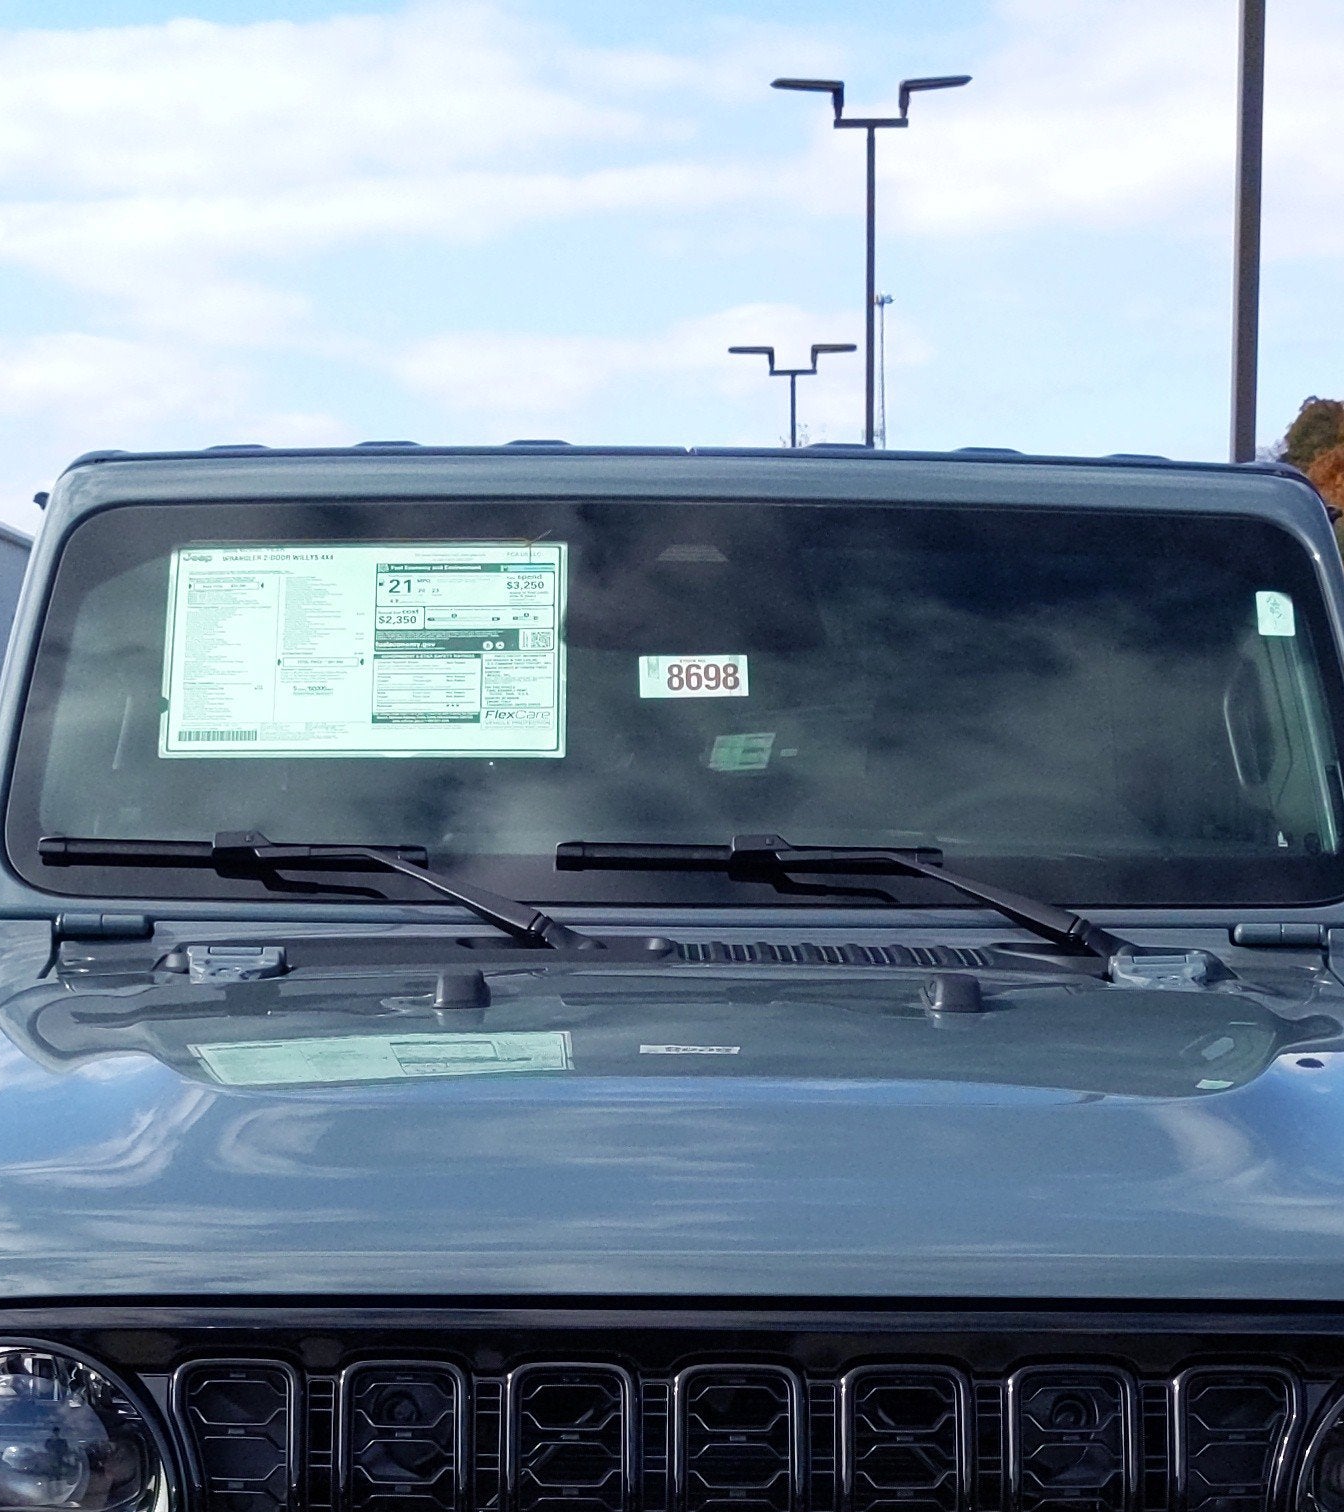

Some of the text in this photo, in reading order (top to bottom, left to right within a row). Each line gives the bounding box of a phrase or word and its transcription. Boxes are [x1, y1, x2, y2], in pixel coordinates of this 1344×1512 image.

[183, 554, 213, 563] Jeep
[222, 554, 262, 562] WRANGLER
[388, 579, 412, 594] 21
[506, 581, 545, 591] $3,250
[378, 615, 417, 625] $2,350
[667, 663, 740, 691] 8698
[485, 710, 551, 720] FlexCare
